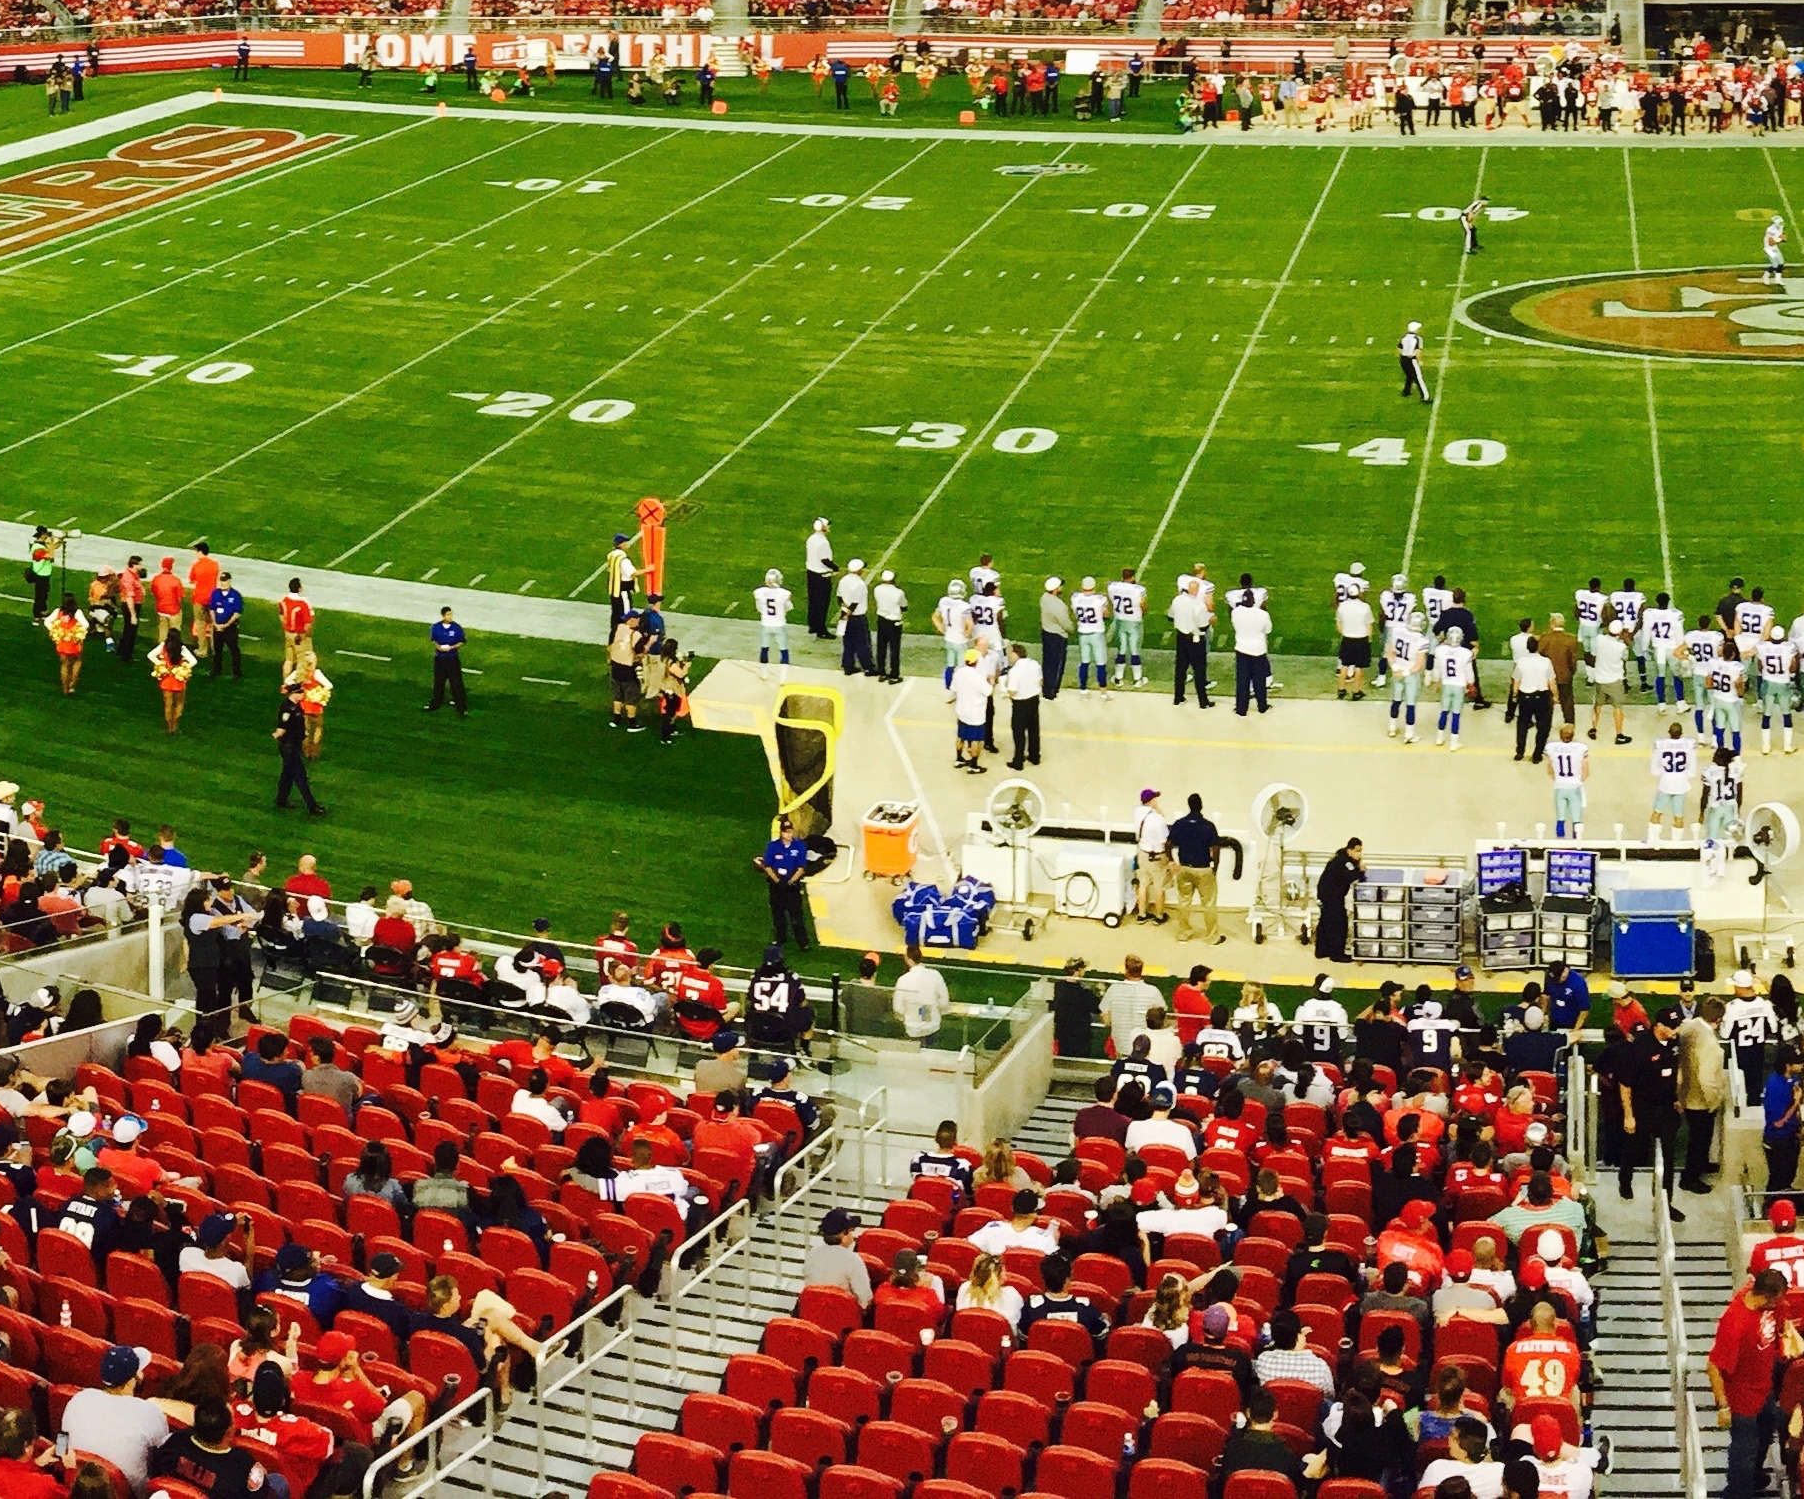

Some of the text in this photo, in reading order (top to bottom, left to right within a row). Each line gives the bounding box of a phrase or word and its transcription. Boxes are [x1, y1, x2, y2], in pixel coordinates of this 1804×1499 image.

[344, 33, 477, 69] HOME
[563, 33, 784, 69] FITHL
[116, 353, 256, 387] 10
[477, 390, 637, 424] 20
[894, 422, 1060, 455] 30
[1347, 437, 1508, 467] 40
[766, 600, 776, 616] 5
[974, 605, 995, 625] 23
[1114, 597, 1134, 614] 72
[1388, 601, 1408, 621] 37
[1578, 601, 1598, 621] 25
[1614, 601, 1636, 621] 24
[1652, 621, 1671, 639] 47
[1742, 612, 1761, 632] 52
[1395, 638, 1411, 662] 91
[1446, 658, 1456, 676] 6
[1766, 655, 1785, 675] 51
[1557, 755, 1574, 777] 11
[1662, 751, 1686, 773] 32
[753, 982, 789, 1013] 54
[1313, 1024, 1331, 1051] 9
[1421, 1028, 1438, 1053] 9
[1737, 1015, 1766, 1047] 24
[1520, 1358, 1566, 1398] 49
